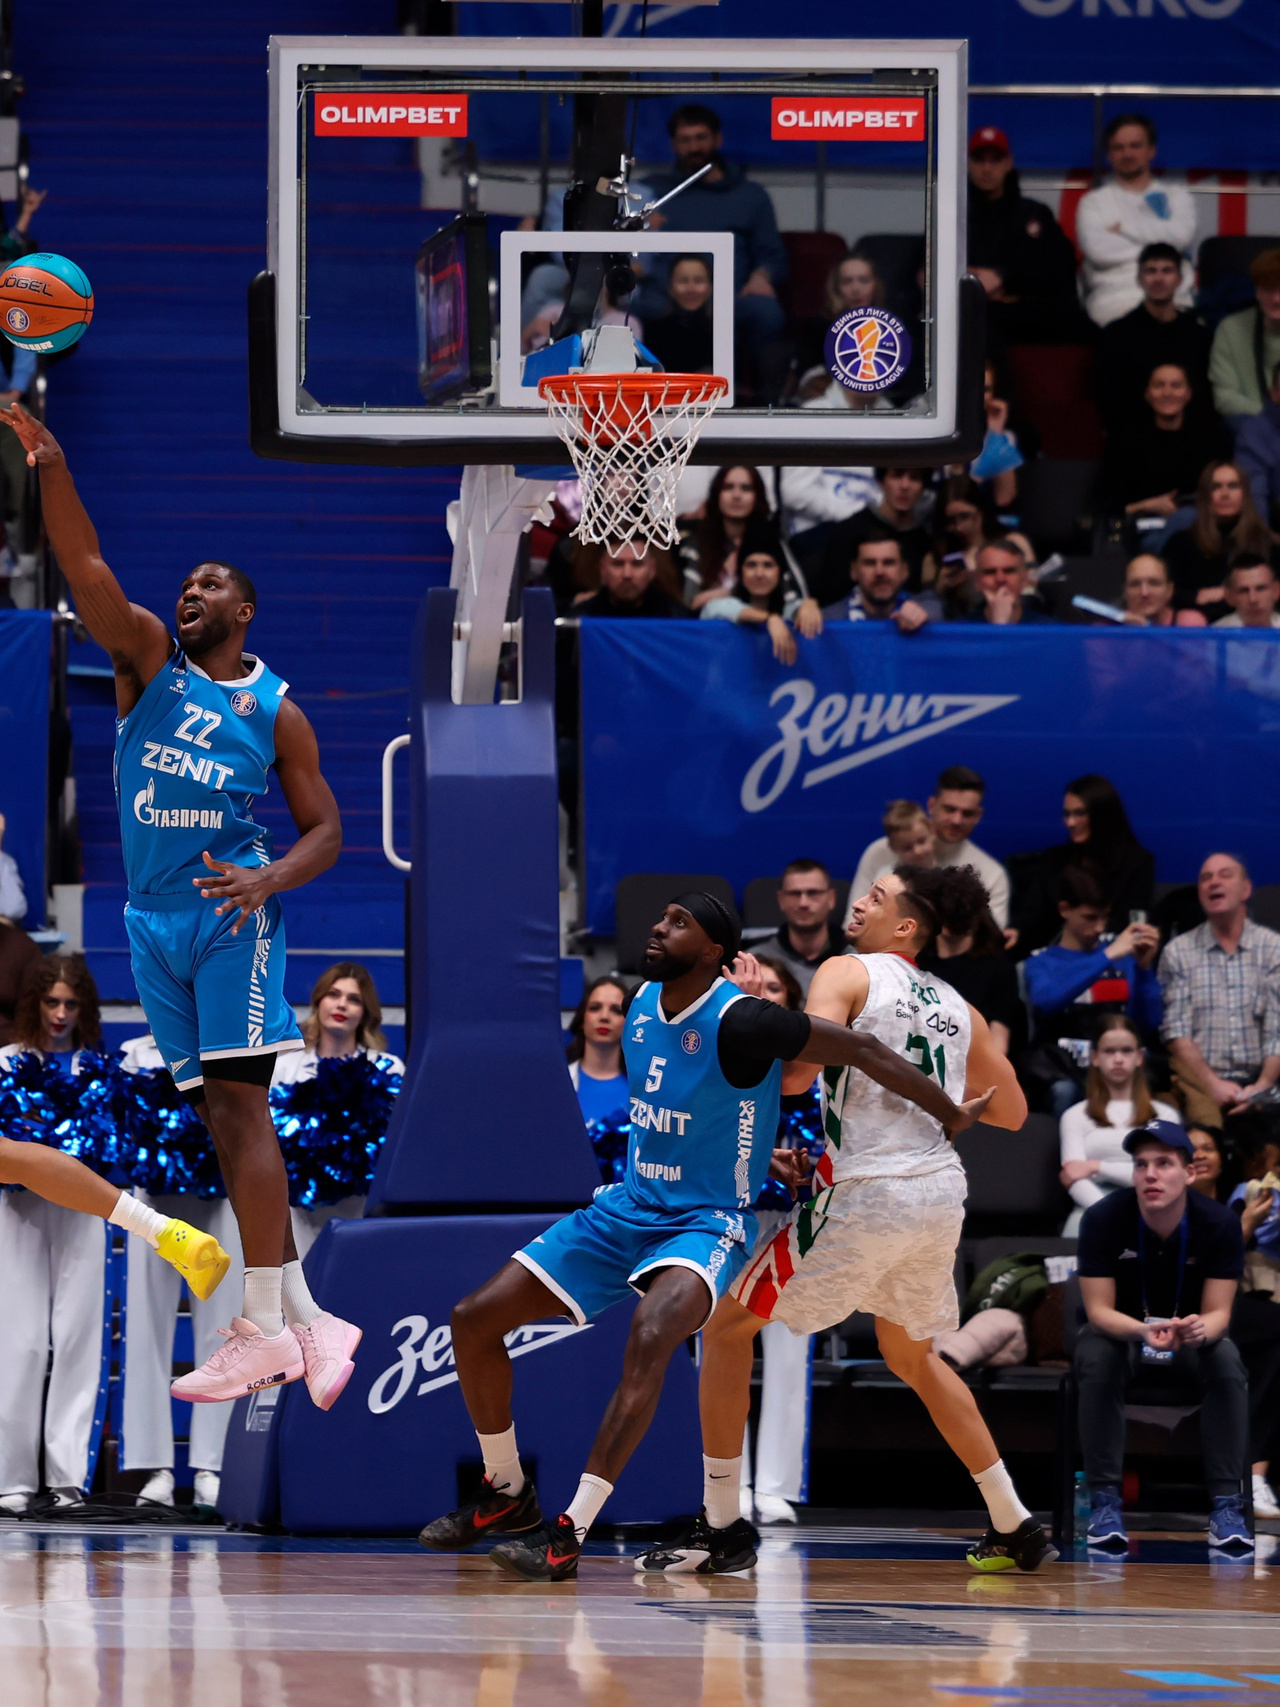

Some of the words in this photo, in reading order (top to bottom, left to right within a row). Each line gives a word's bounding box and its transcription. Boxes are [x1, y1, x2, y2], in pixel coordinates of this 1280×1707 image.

[320, 106, 461, 124] OLIMPBET
[777, 110, 918, 128] OLIMPBET
[0, 274, 53, 297] JÖGEL
[830, 308, 864, 334] ЕДИНАЯ
[865, 307, 889, 321] ЛИГА
[888, 317, 904, 334] ВТБ
[830, 364, 844, 381] VTB
[843, 378, 874, 391] UNITED
[875, 365, 904, 389] LEAGUE
[174, 701, 222, 750] 22
[141, 741, 235, 791] ZENIT
[154, 808, 224, 830] ГАЗПРОМ
[908, 1001, 920, 1014] Бар
[644, 1055, 667, 1093] 5
[629, 1096, 692, 1136] ZENIT
